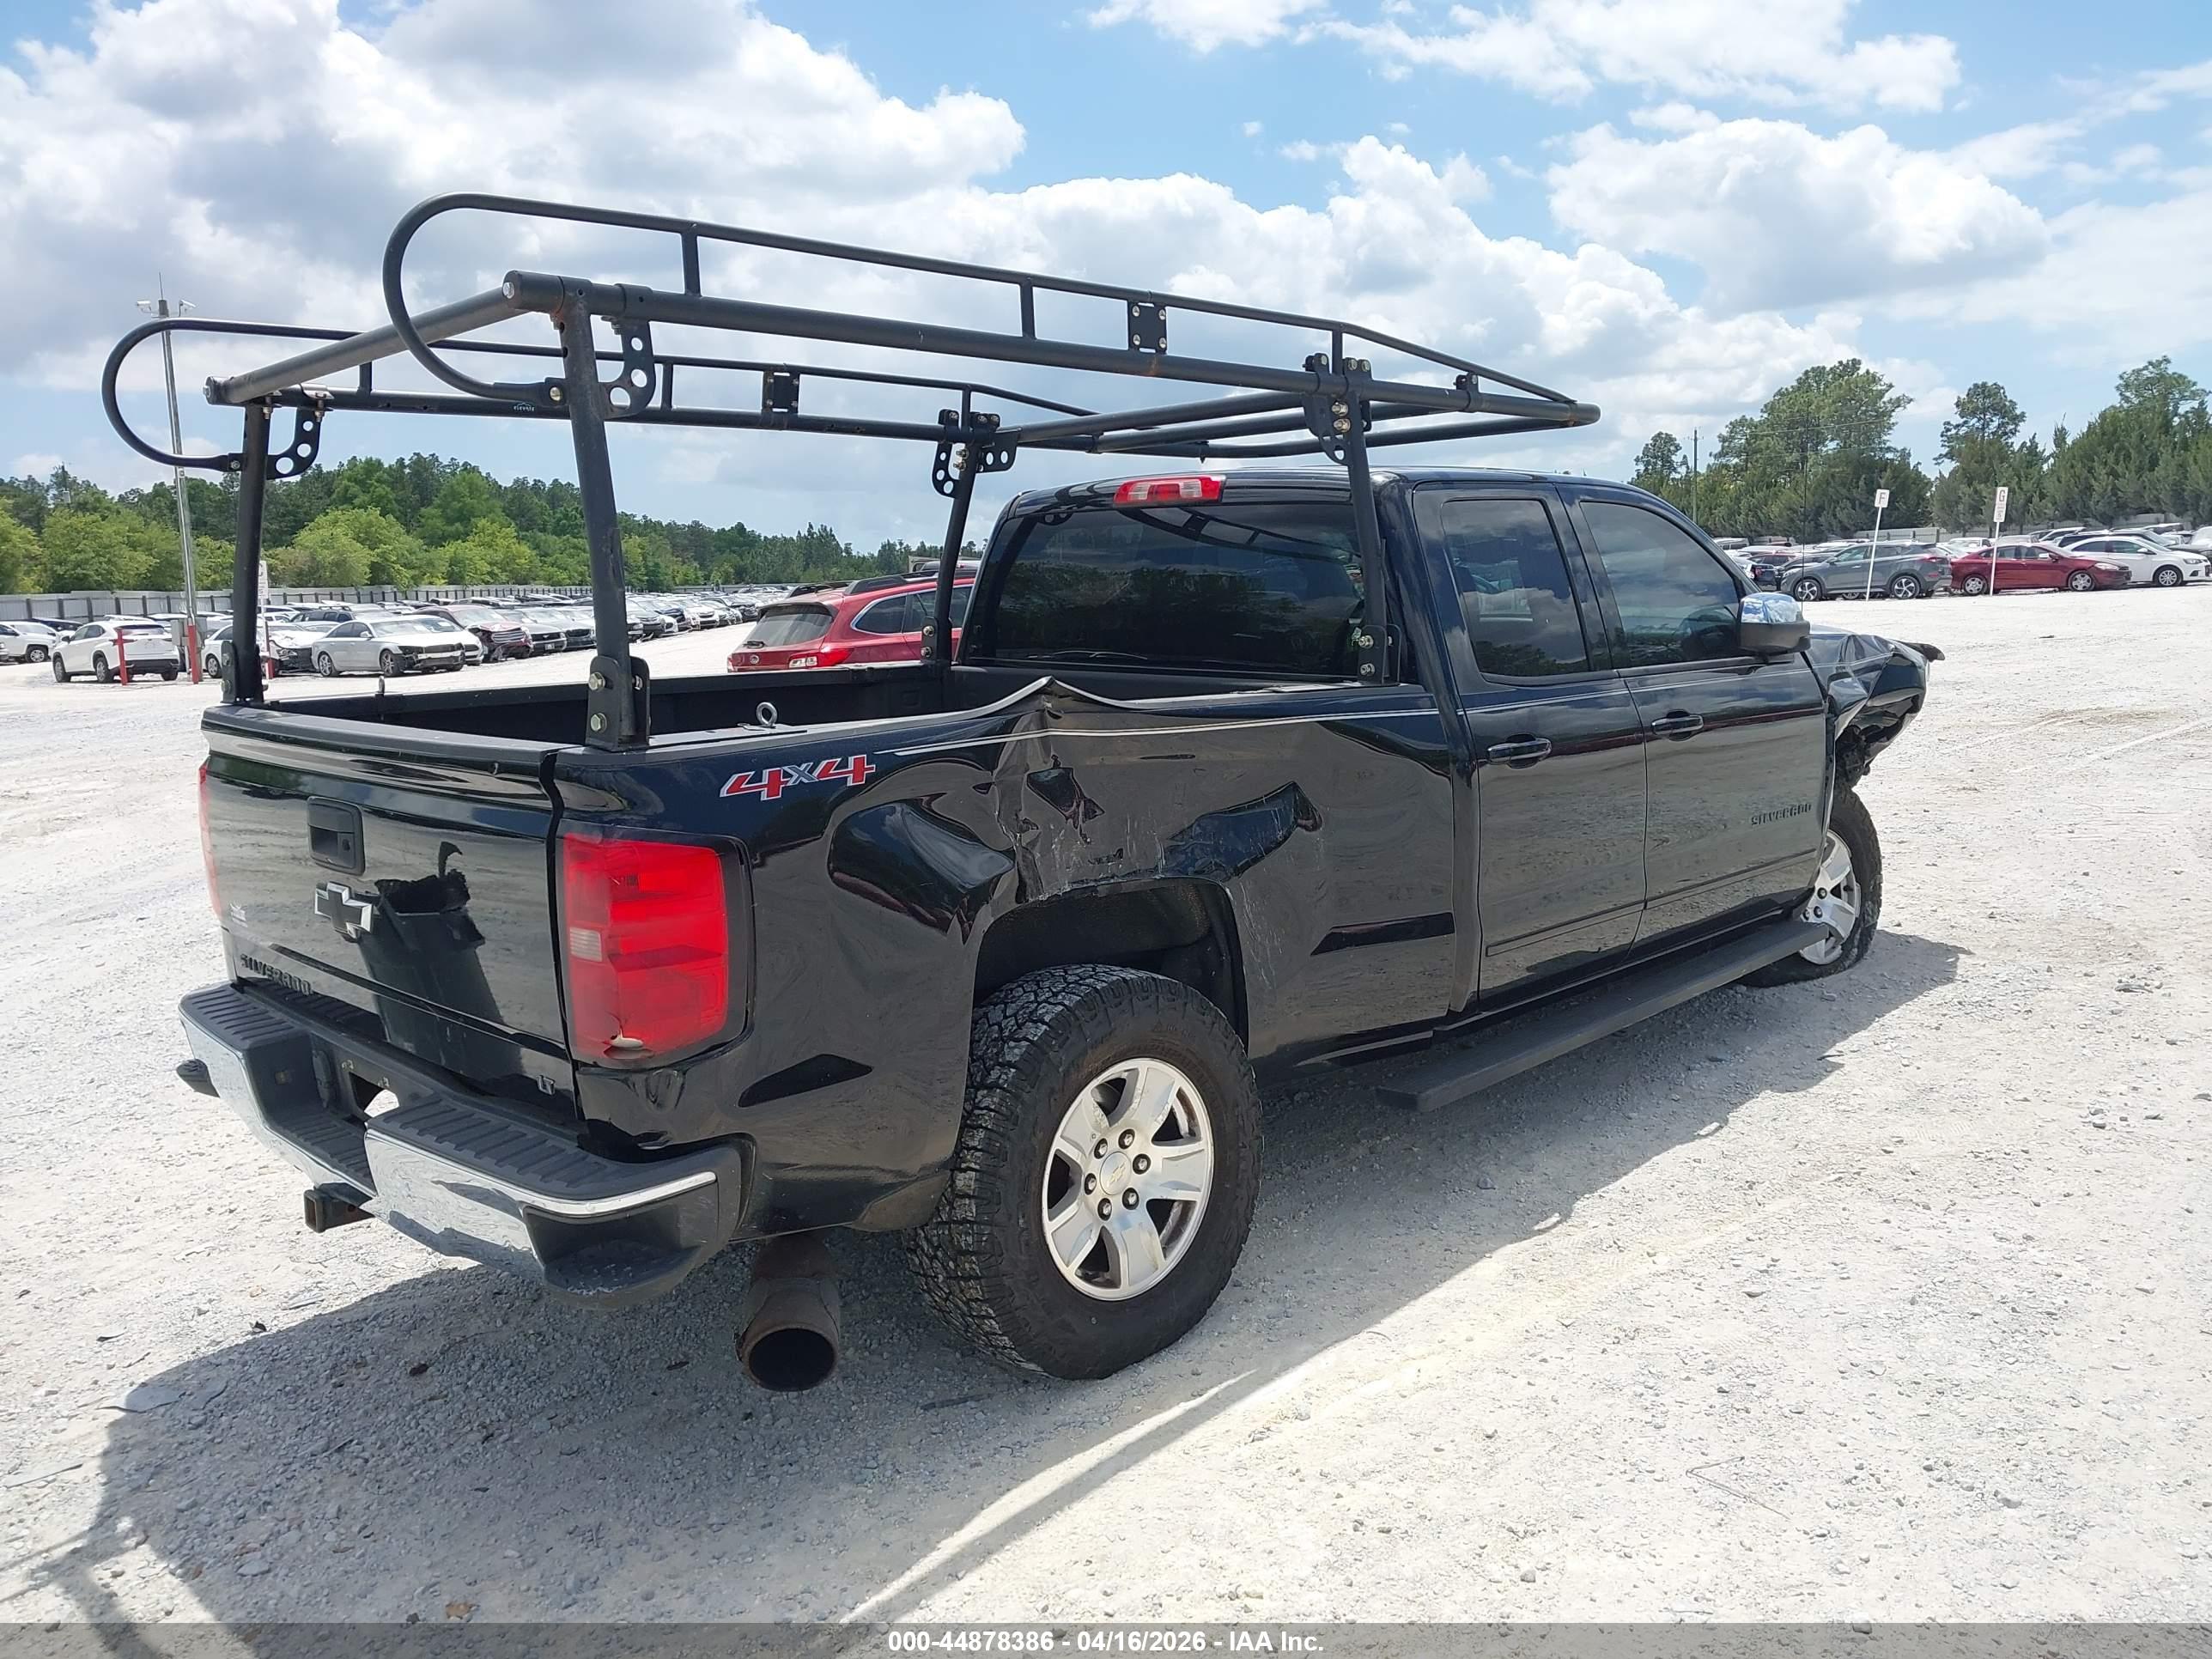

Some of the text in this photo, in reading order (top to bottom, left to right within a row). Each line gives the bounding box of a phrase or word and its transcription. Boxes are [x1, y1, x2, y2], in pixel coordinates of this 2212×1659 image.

[1879, 492, 1887, 505] F
[1998, 489, 2006, 502] G
[1751, 803, 1812, 826] SILVERADO
[240, 953, 313, 995] SILVERADO
[536, 1073, 556, 1096] LT
